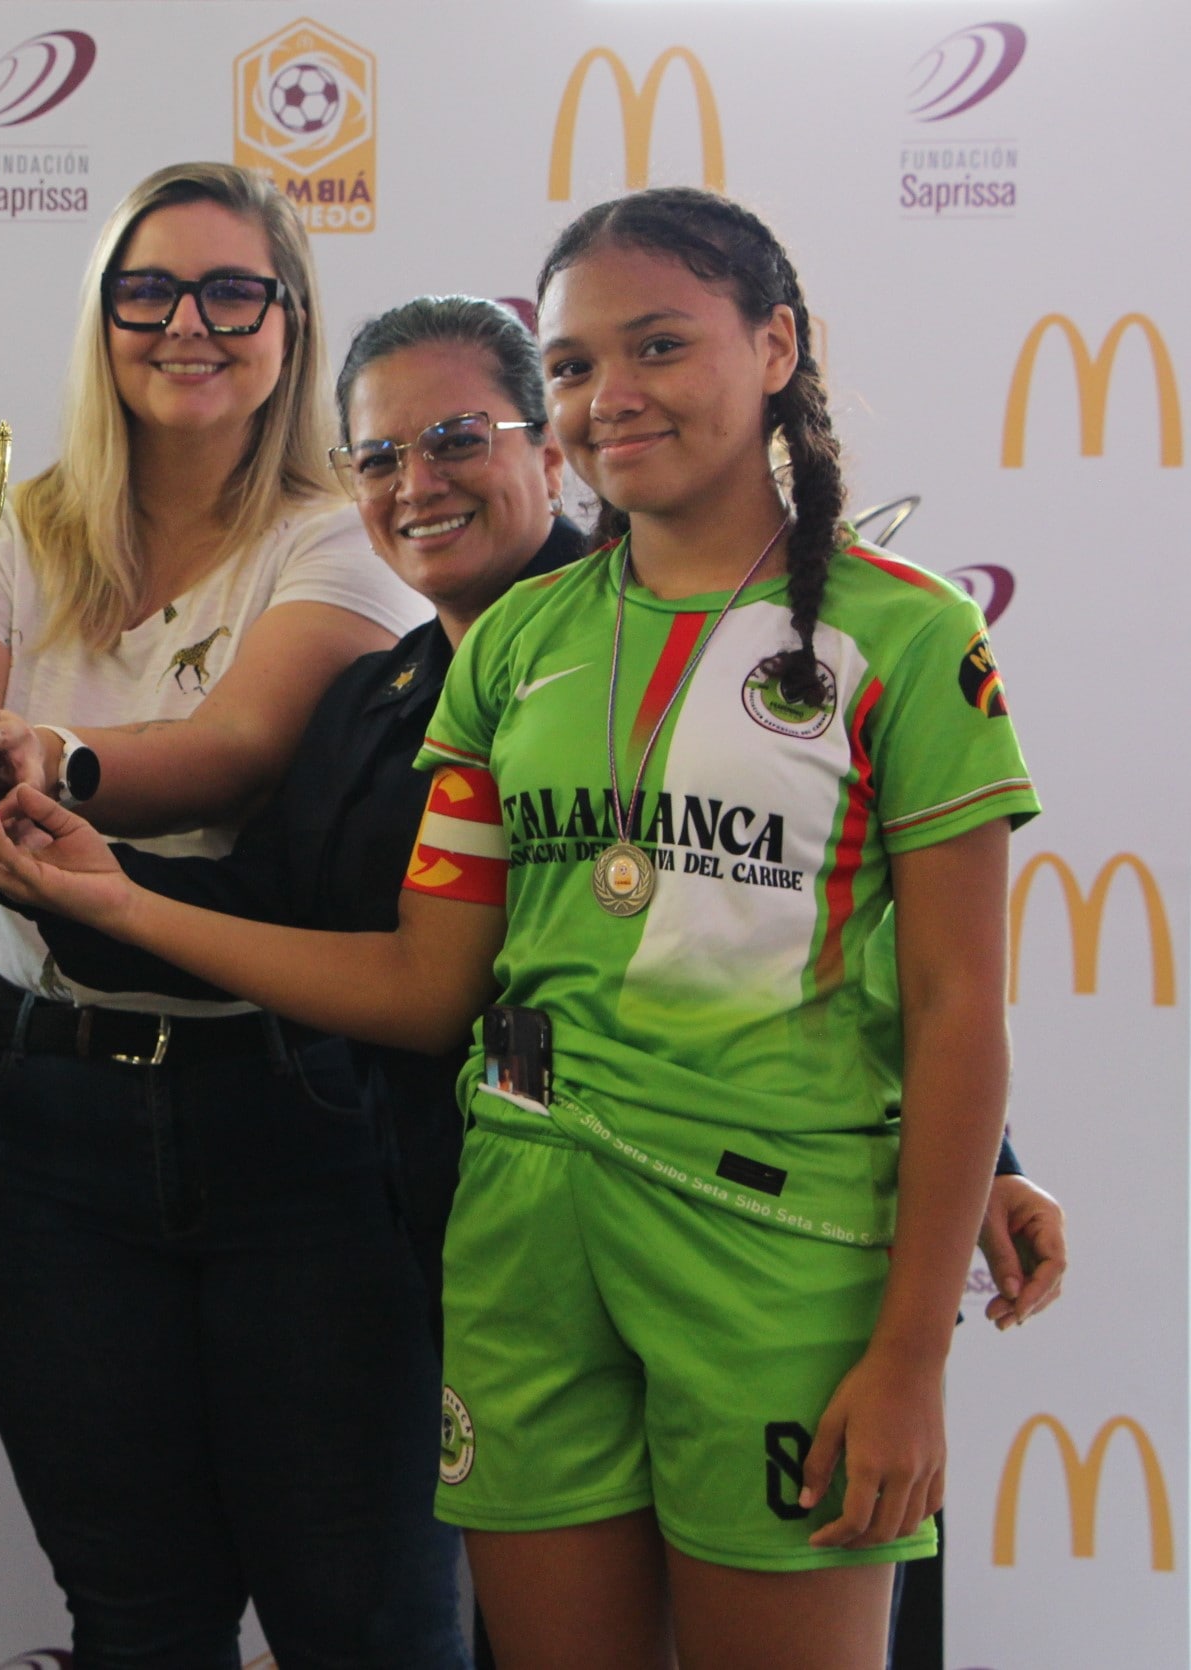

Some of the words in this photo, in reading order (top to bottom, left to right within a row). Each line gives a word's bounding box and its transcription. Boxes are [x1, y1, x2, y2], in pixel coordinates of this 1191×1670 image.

[285, 170, 371, 203] MBIÁ
[900, 173, 1016, 214] Saprissa
[684, 853, 724, 879] DEL
[732, 863, 804, 892] CARIBE
[692, 1176, 729, 1201] Seta
[776, 1208, 813, 1231] Seta
